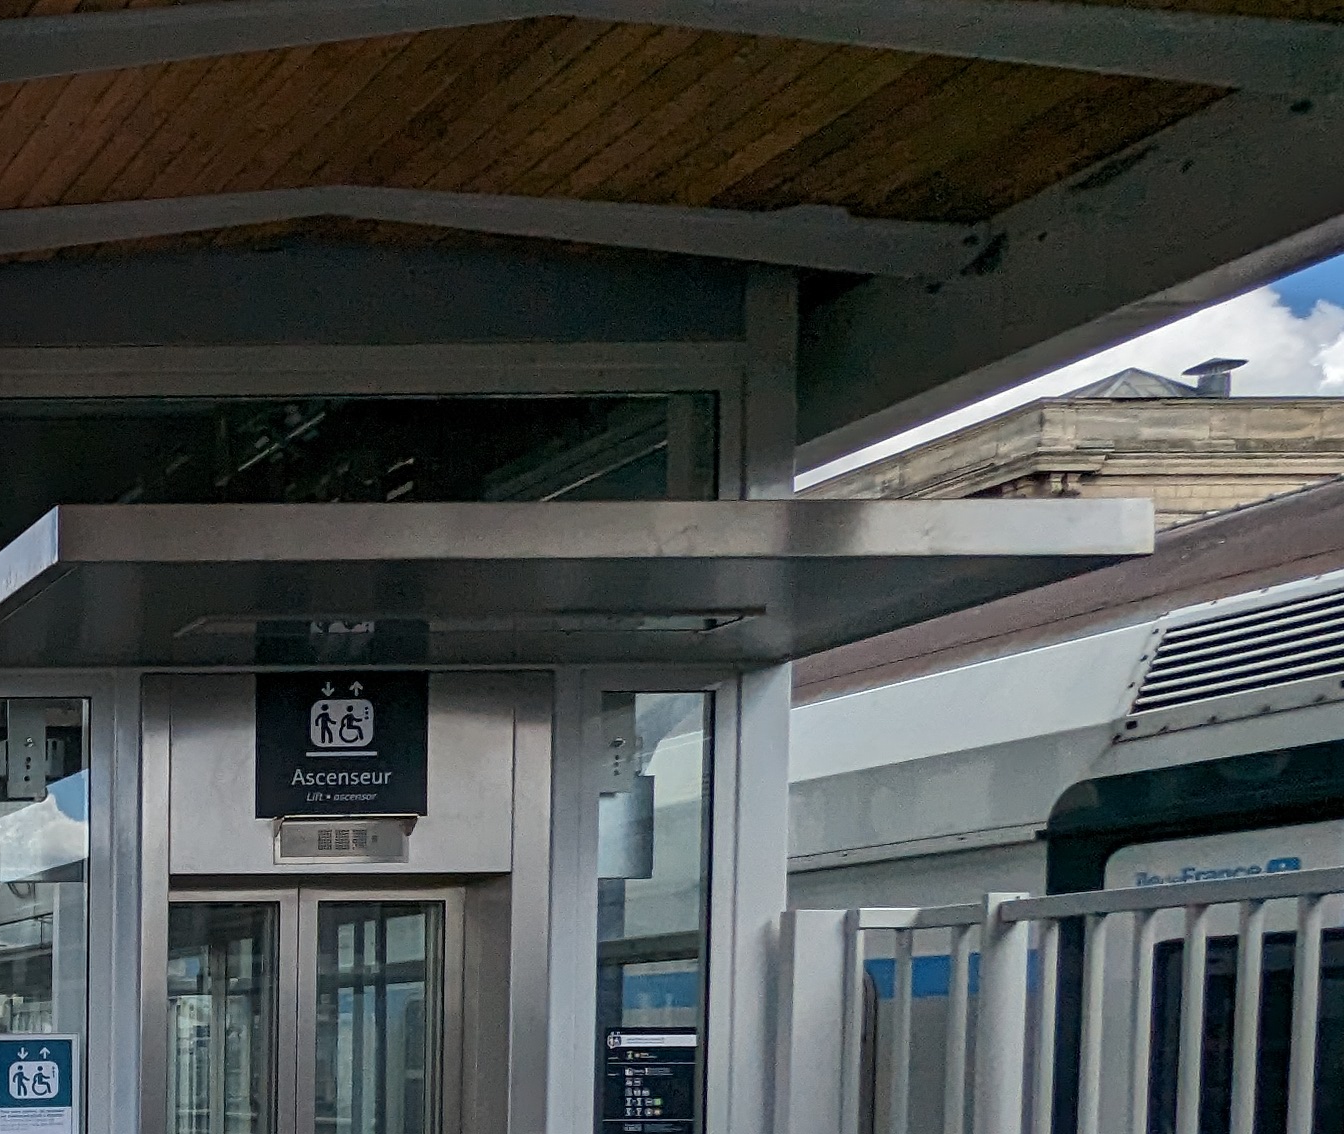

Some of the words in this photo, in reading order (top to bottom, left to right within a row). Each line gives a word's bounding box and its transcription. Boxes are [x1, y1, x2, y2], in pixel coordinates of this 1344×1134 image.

[291, 768, 392, 786] Ascenseur
[306, 791, 323, 802] Lift
[333, 793, 377, 801] ascensor
